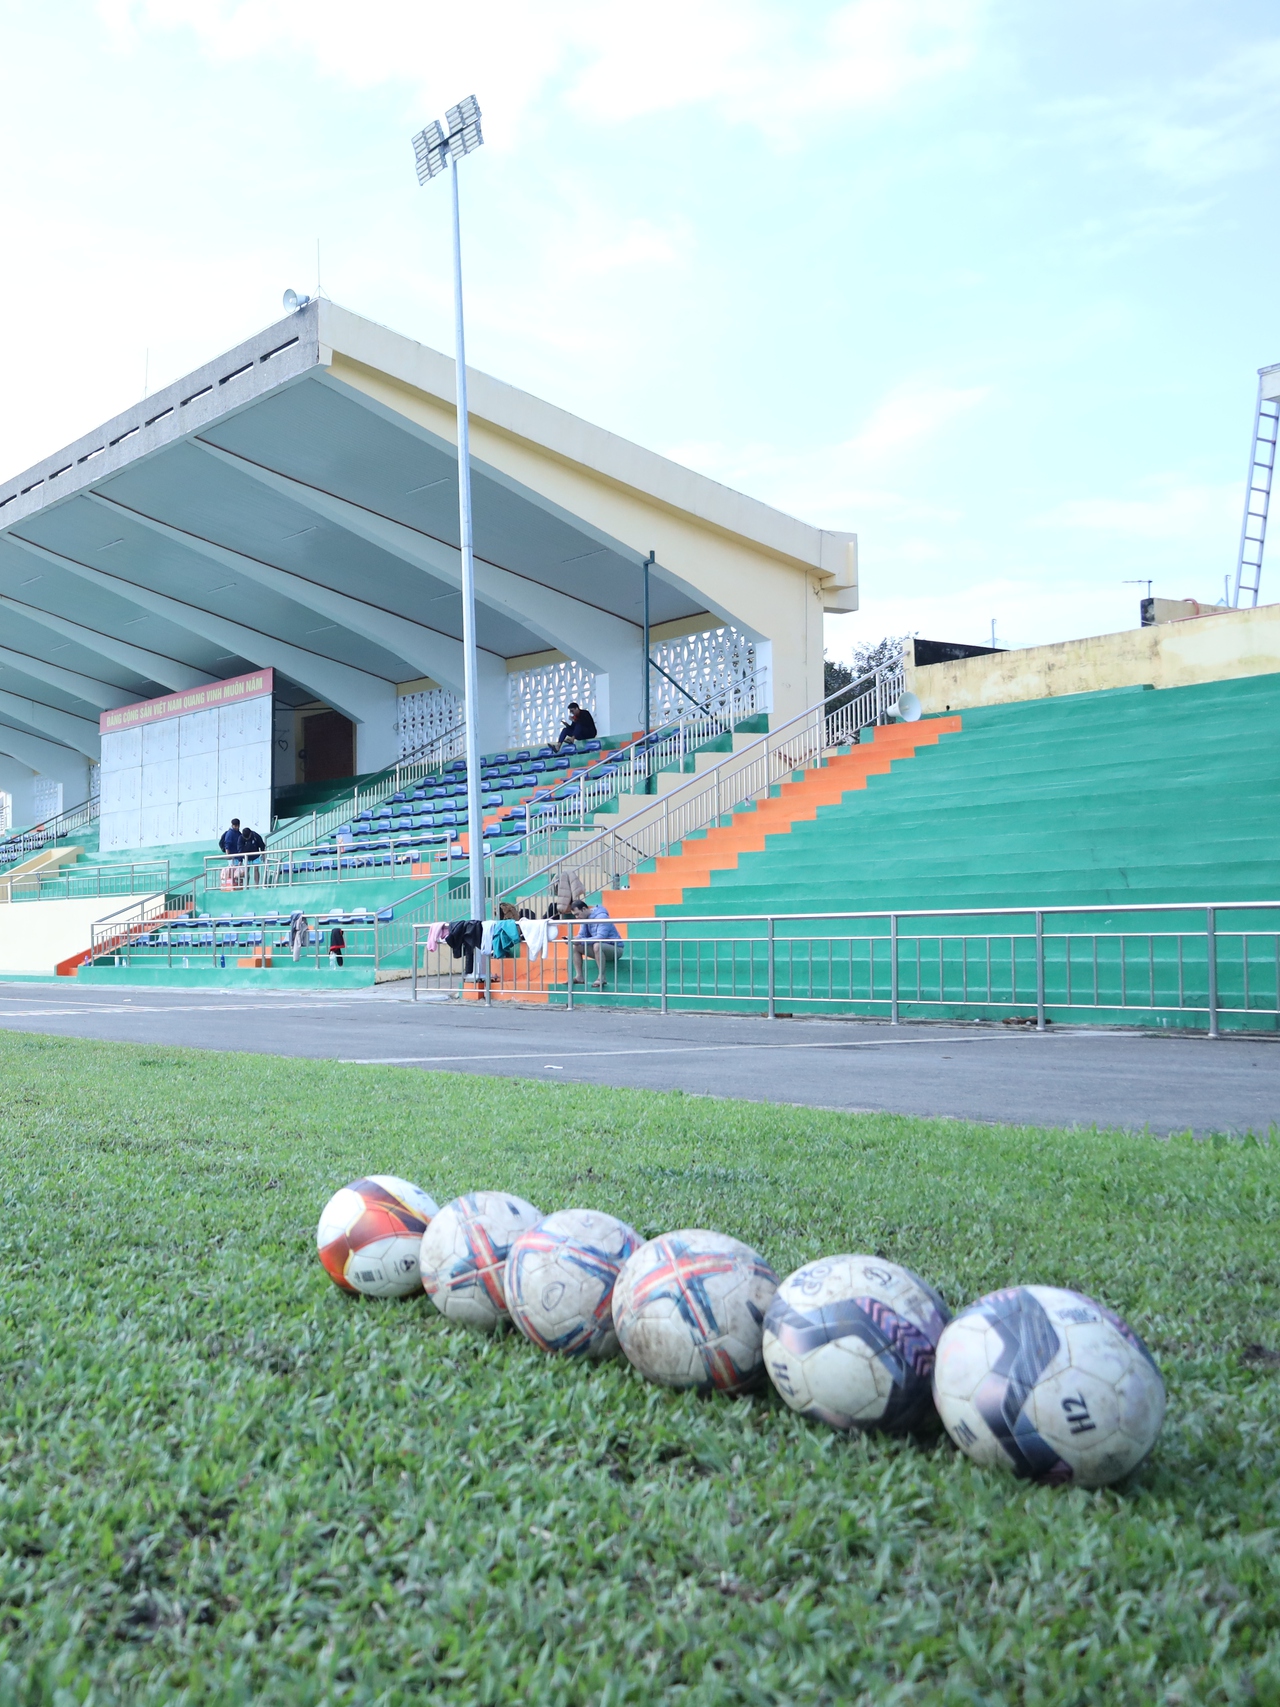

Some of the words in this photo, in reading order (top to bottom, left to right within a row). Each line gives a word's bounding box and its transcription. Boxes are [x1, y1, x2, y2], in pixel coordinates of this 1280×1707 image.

[106, 713, 122, 727] ĐẢNG
[123, 709, 139, 724] CỘNG
[140, 703, 153, 719] SẢN
[153, 701, 167, 716] VIỆT
[167, 698, 182, 712] NAM
[183, 692, 205, 709] QUANG
[206, 687, 222, 702] VINH
[223, 681, 245, 698] MUÔN
[245, 676, 263, 693] NĂM
[1061, 1389, 1096, 1435] H2
